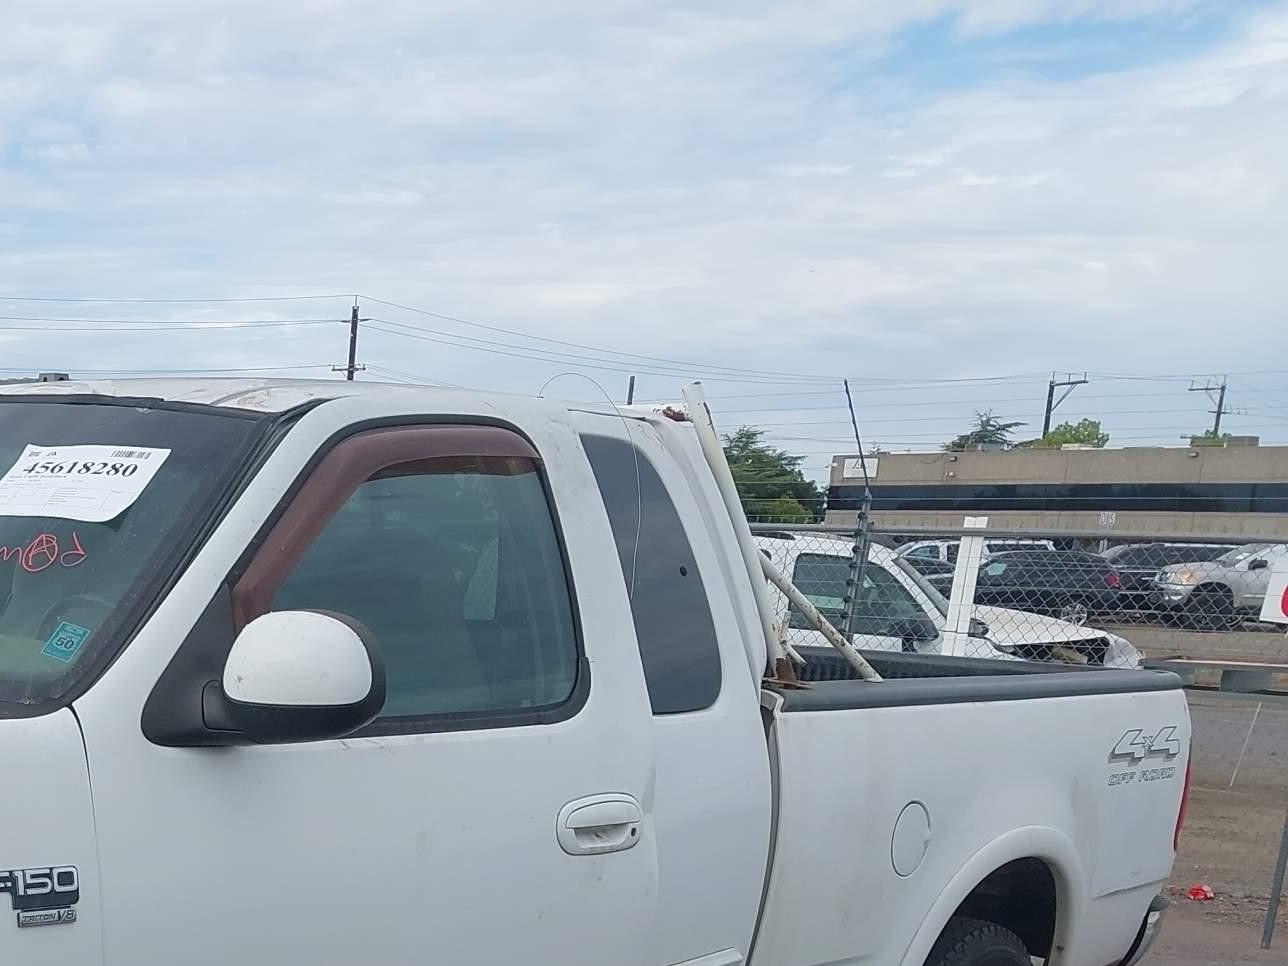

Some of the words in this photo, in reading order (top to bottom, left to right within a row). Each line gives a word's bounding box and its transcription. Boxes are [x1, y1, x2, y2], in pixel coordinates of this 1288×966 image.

[23, 461, 138, 478] 45618280
[55, 636, 74, 650] 50
[1108, 771, 1137, 786] OFF
[1138, 766, 1176, 782] ROAD
[21, 913, 56, 922] TRITON
[57, 909, 76, 921] V8
